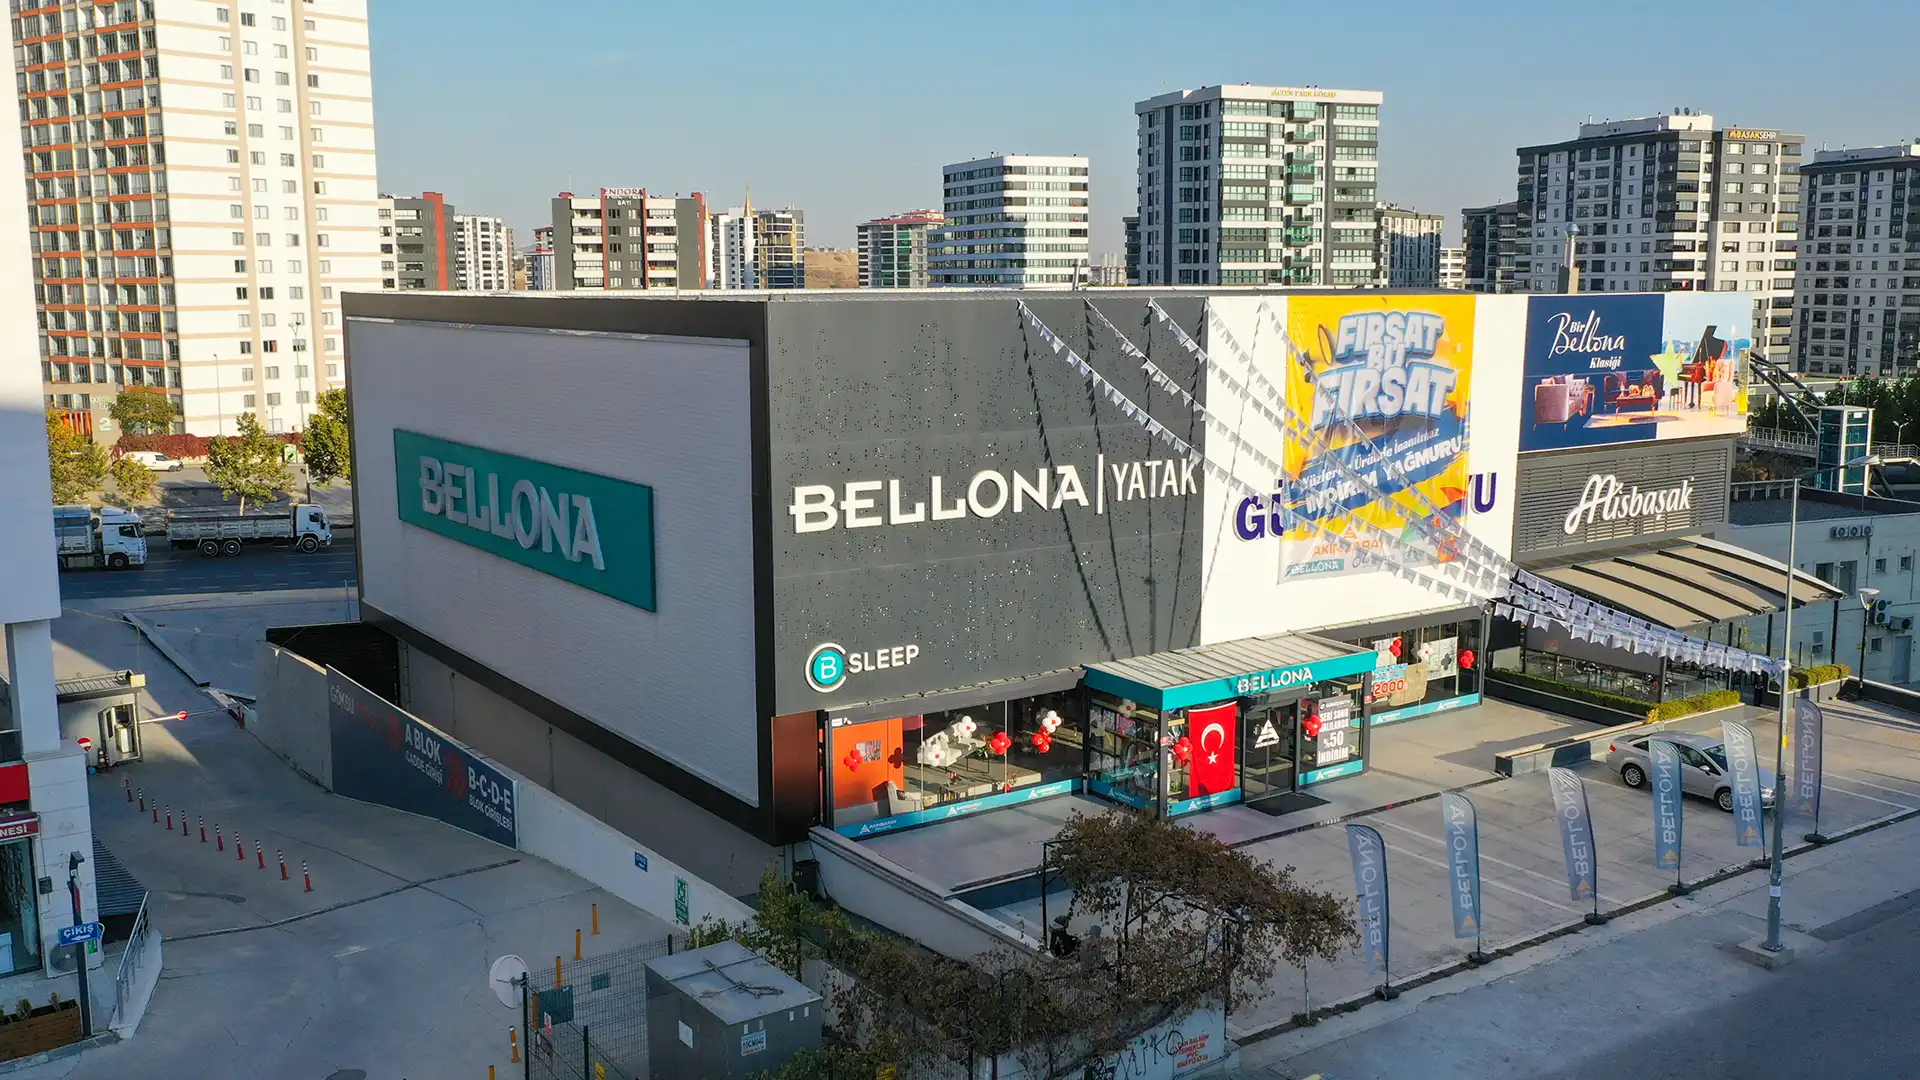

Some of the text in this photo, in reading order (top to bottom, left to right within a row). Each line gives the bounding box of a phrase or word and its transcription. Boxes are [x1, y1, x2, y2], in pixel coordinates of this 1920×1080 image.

[1336, 311, 1444, 362] FIRSAT
[1547, 310, 1625, 359] Bellona
[1569, 321, 1586, 334] Bir
[1366, 342, 1406, 372] BU
[1589, 356, 1622, 371] Klasiği
[1312, 362, 1457, 430] FIRSAT
[789, 458, 1198, 533] BELLONA YATAK
[419, 456, 606, 571] BELLONA
[1290, 560, 1341, 575] BELLONA
[848, 645, 920, 674] SLEEP
[1237, 667, 1313, 694] BELLONA
[1373, 679, 1405, 697] 2000
[405, 724, 442, 765] A BLOK
[1323, 730, 1344, 749] %50
[468, 766, 512, 814] B-C-D-E
[63, 925, 95, 939] ÇIKIŞ
